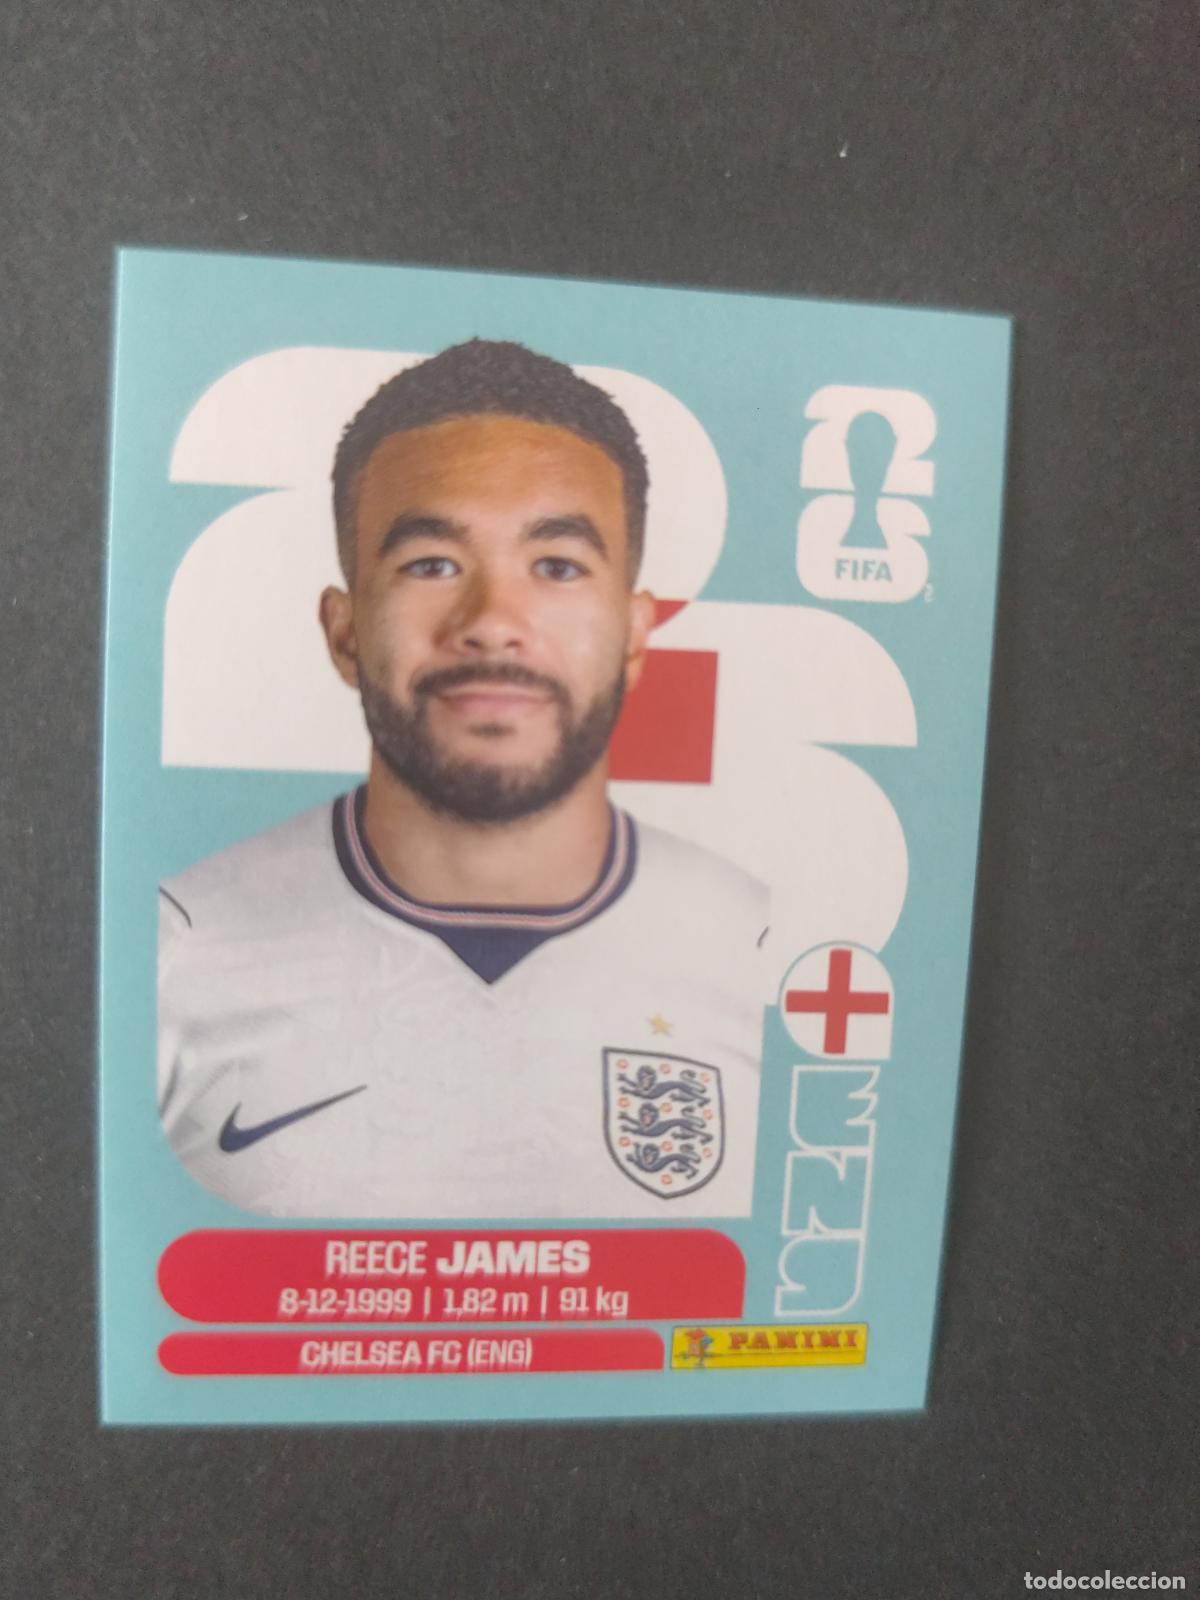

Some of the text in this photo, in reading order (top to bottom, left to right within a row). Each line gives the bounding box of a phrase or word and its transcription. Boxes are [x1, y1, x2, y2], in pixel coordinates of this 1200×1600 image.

[834, 557, 893, 582] FIFA
[326, 1240, 591, 1276] REECE JAMES
[279, 1287, 413, 1316] 8-12-1999
[503, 1291, 529, 1313] m
[559, 1286, 590, 1313] 91
[595, 1285, 629, 1317] kg
[301, 1337, 533, 1367] CHELSEA FC (ENG)
[728, 1329, 859, 1351] PANINI
